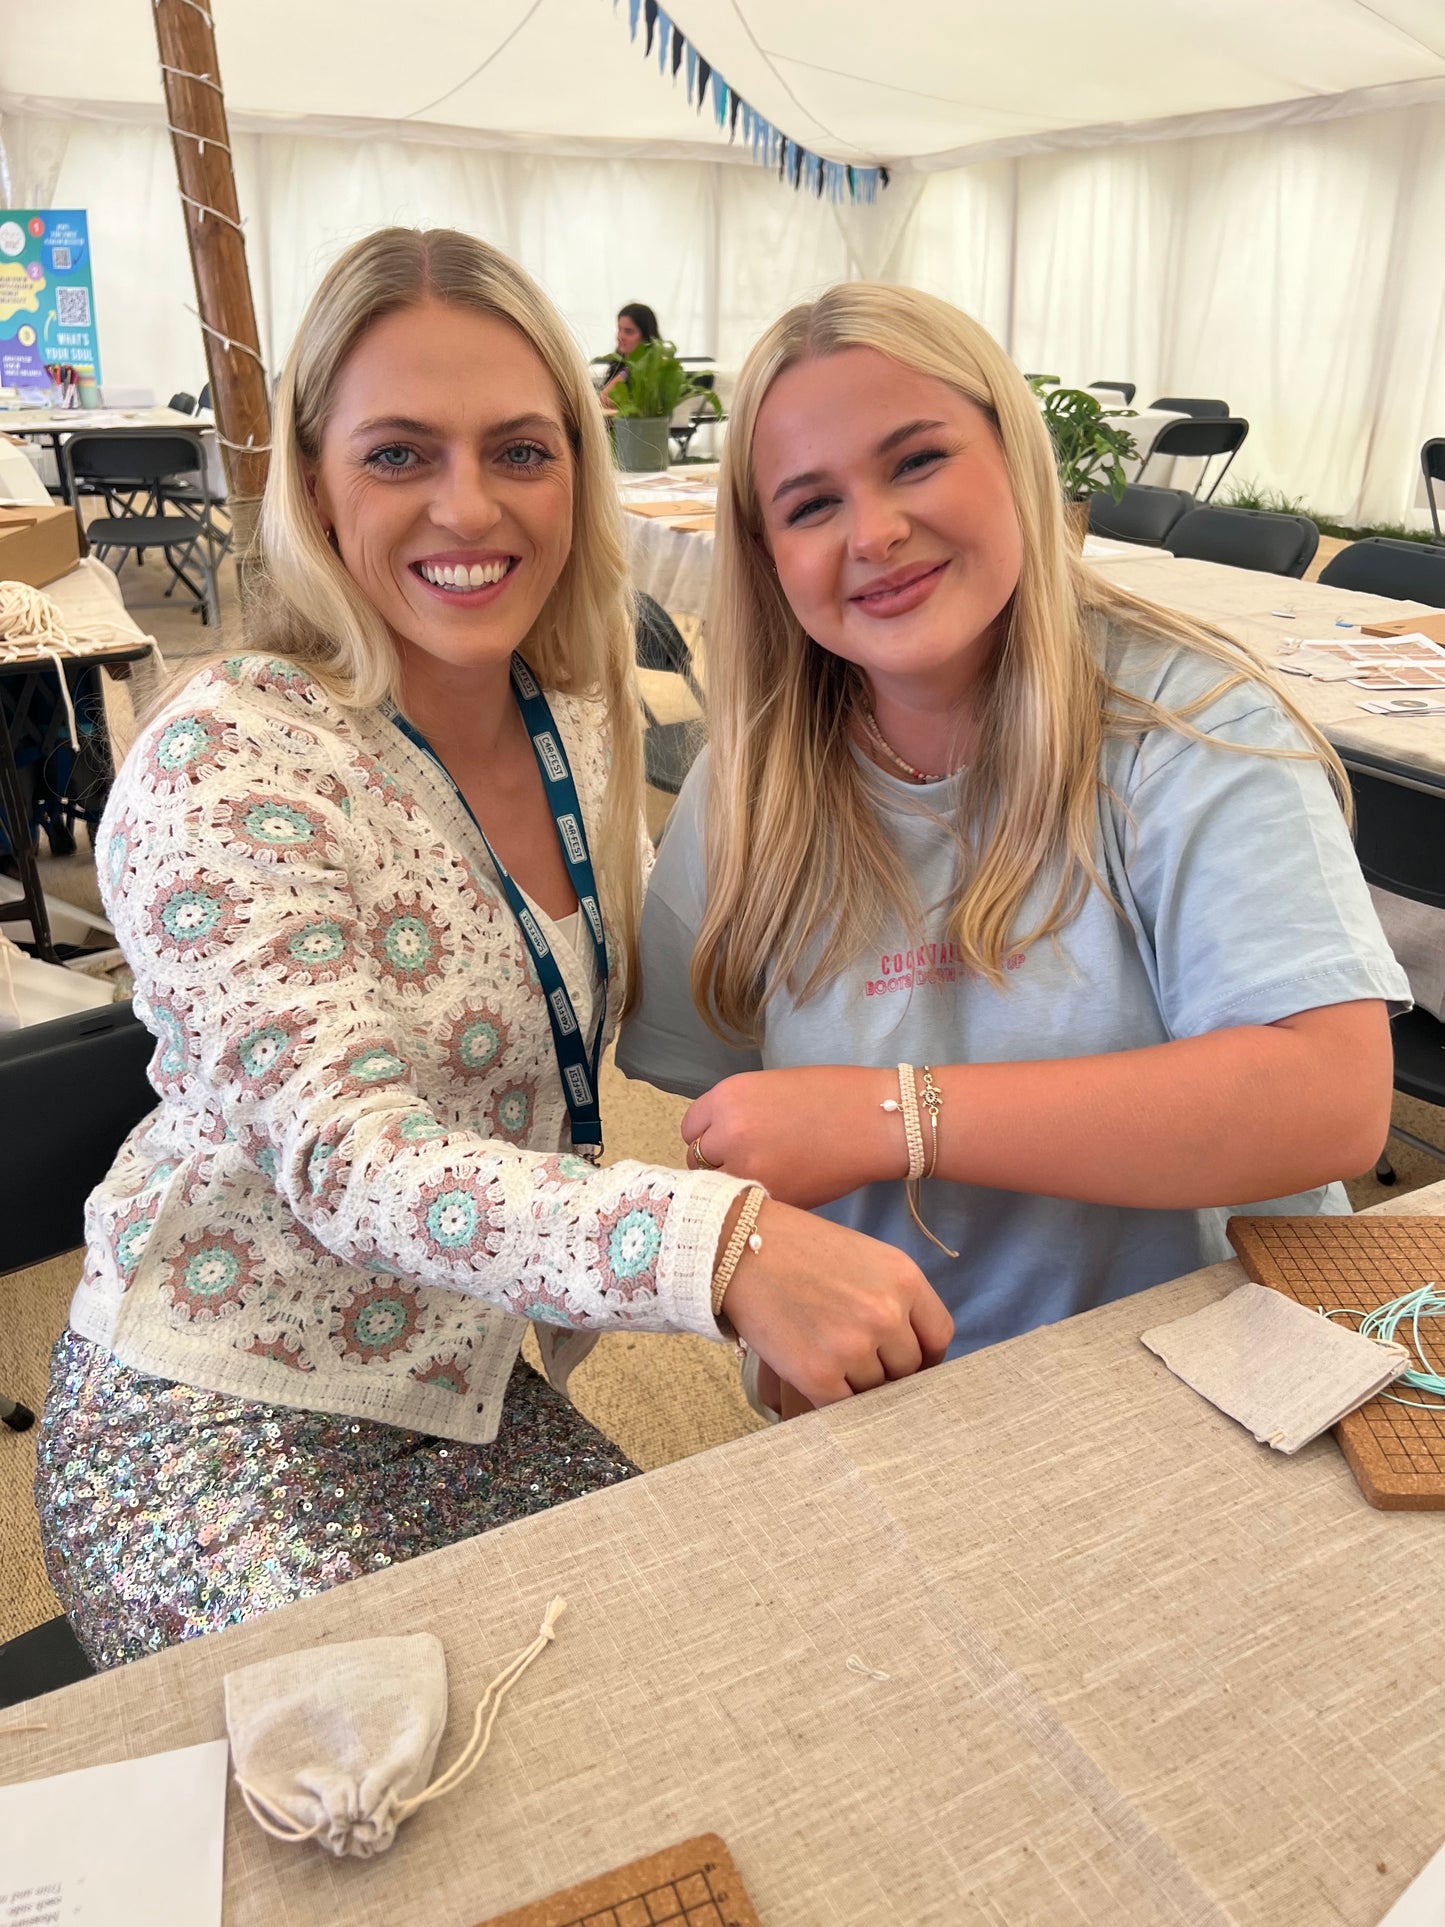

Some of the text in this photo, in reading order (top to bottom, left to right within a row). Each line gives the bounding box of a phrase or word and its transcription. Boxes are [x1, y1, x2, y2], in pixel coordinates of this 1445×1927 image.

[56, 332, 90, 346] WHAT'S
[45, 347, 70, 360] YOUR
[865, 973, 913, 996] BOOTS
